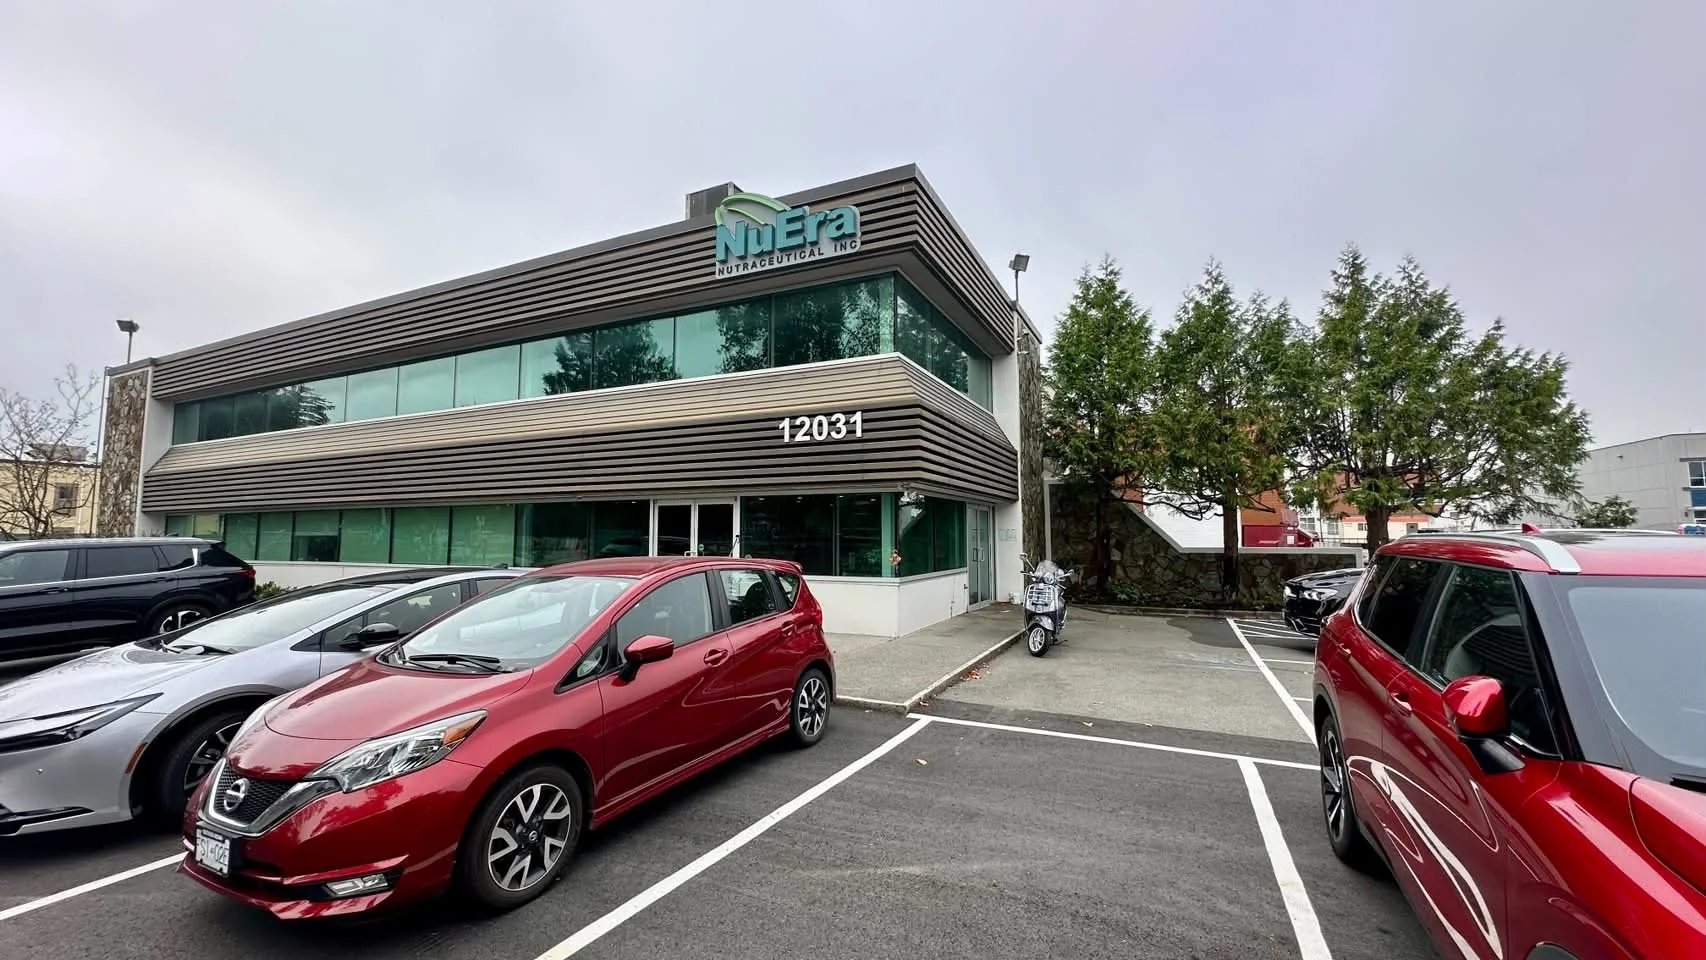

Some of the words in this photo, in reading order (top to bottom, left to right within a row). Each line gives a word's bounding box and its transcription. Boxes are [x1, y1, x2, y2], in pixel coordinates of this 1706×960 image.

[716, 206, 856, 262] NuEra
[718, 249, 824, 276] NUTRACEUTICAL
[834, 240, 857, 253] INC
[779, 411, 862, 442] 12031
